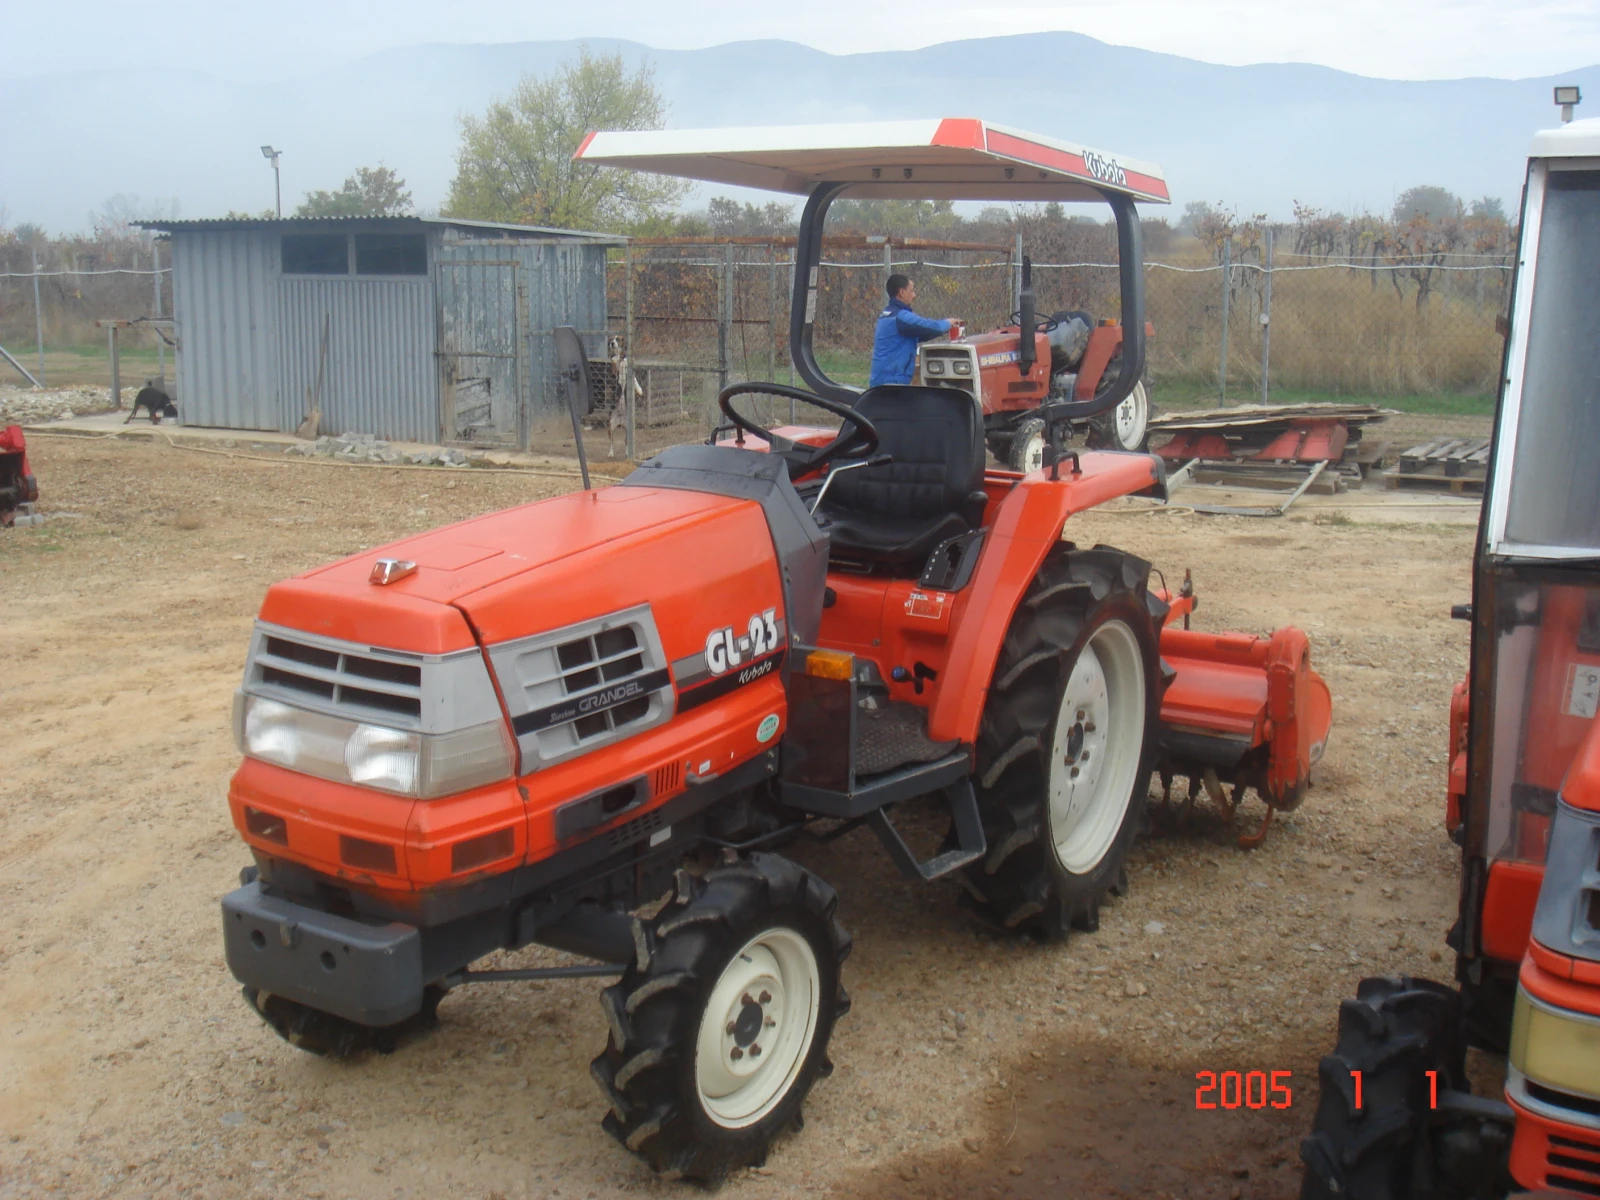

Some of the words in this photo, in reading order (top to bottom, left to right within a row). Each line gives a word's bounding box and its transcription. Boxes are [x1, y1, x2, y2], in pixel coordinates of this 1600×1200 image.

[1082, 150, 1127, 187] Kubota
[704, 606, 778, 677] GL-23
[738, 660, 773, 685] Kubota
[578, 681, 644, 712] GRANDEL
